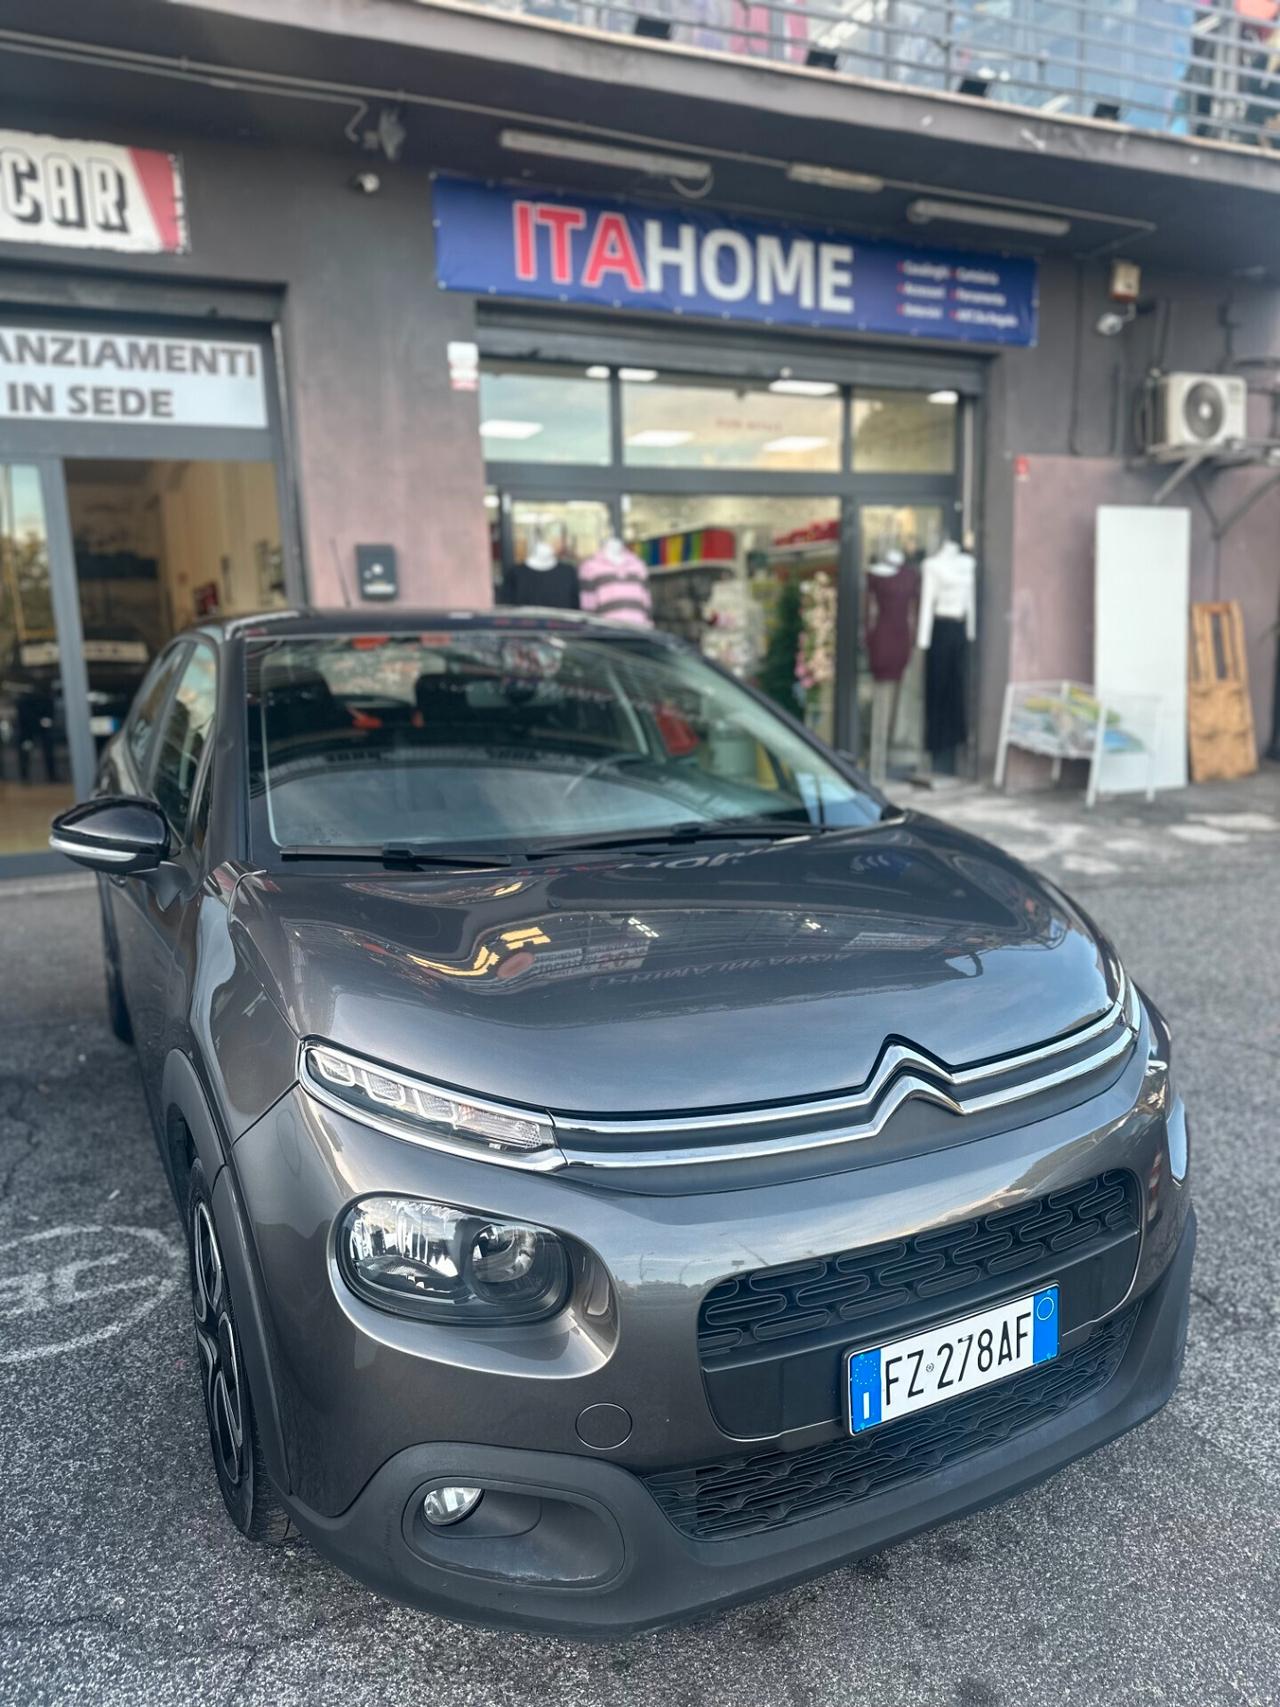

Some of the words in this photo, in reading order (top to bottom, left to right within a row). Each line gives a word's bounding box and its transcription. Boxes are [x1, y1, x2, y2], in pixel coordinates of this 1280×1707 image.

[513, 201, 853, 313] ITAHOME
[7, 382, 56, 414] IN
[68, 386, 173, 418] SEDE
